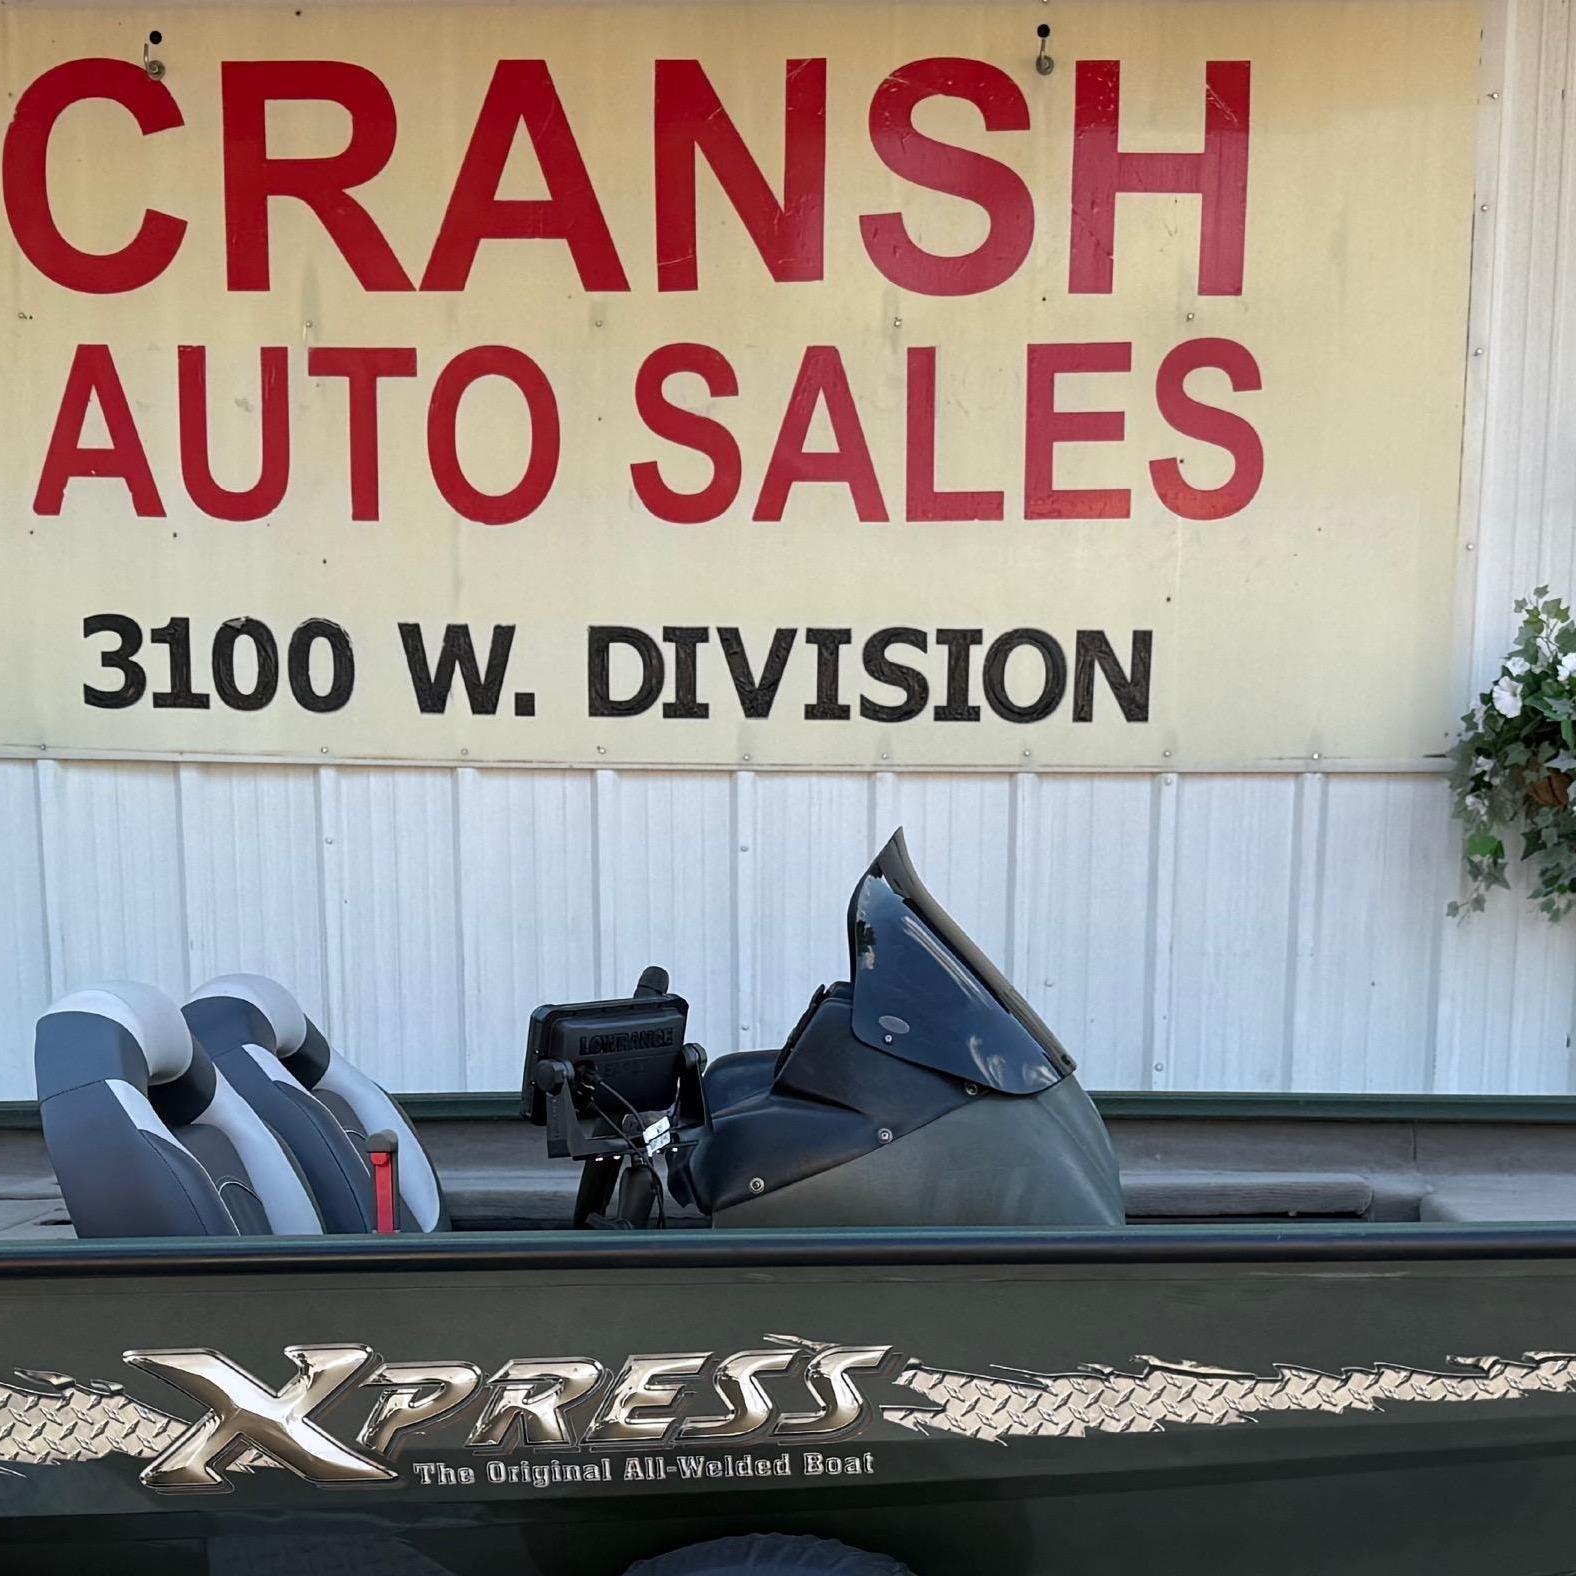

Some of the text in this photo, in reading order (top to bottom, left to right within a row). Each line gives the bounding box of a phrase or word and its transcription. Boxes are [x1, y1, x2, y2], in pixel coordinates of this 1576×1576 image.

[3, 57, 1252, 295] CRANSH
[34, 338, 1264, 525] AUTO SALES
[83, 613, 1155, 725] 3100 W. DIVISION
[578, 1027, 674, 1056] LOWRANCE
[122, 1341, 898, 1489] XPRESS
[413, 1452, 875, 1488] The Original All-Welded Boat
